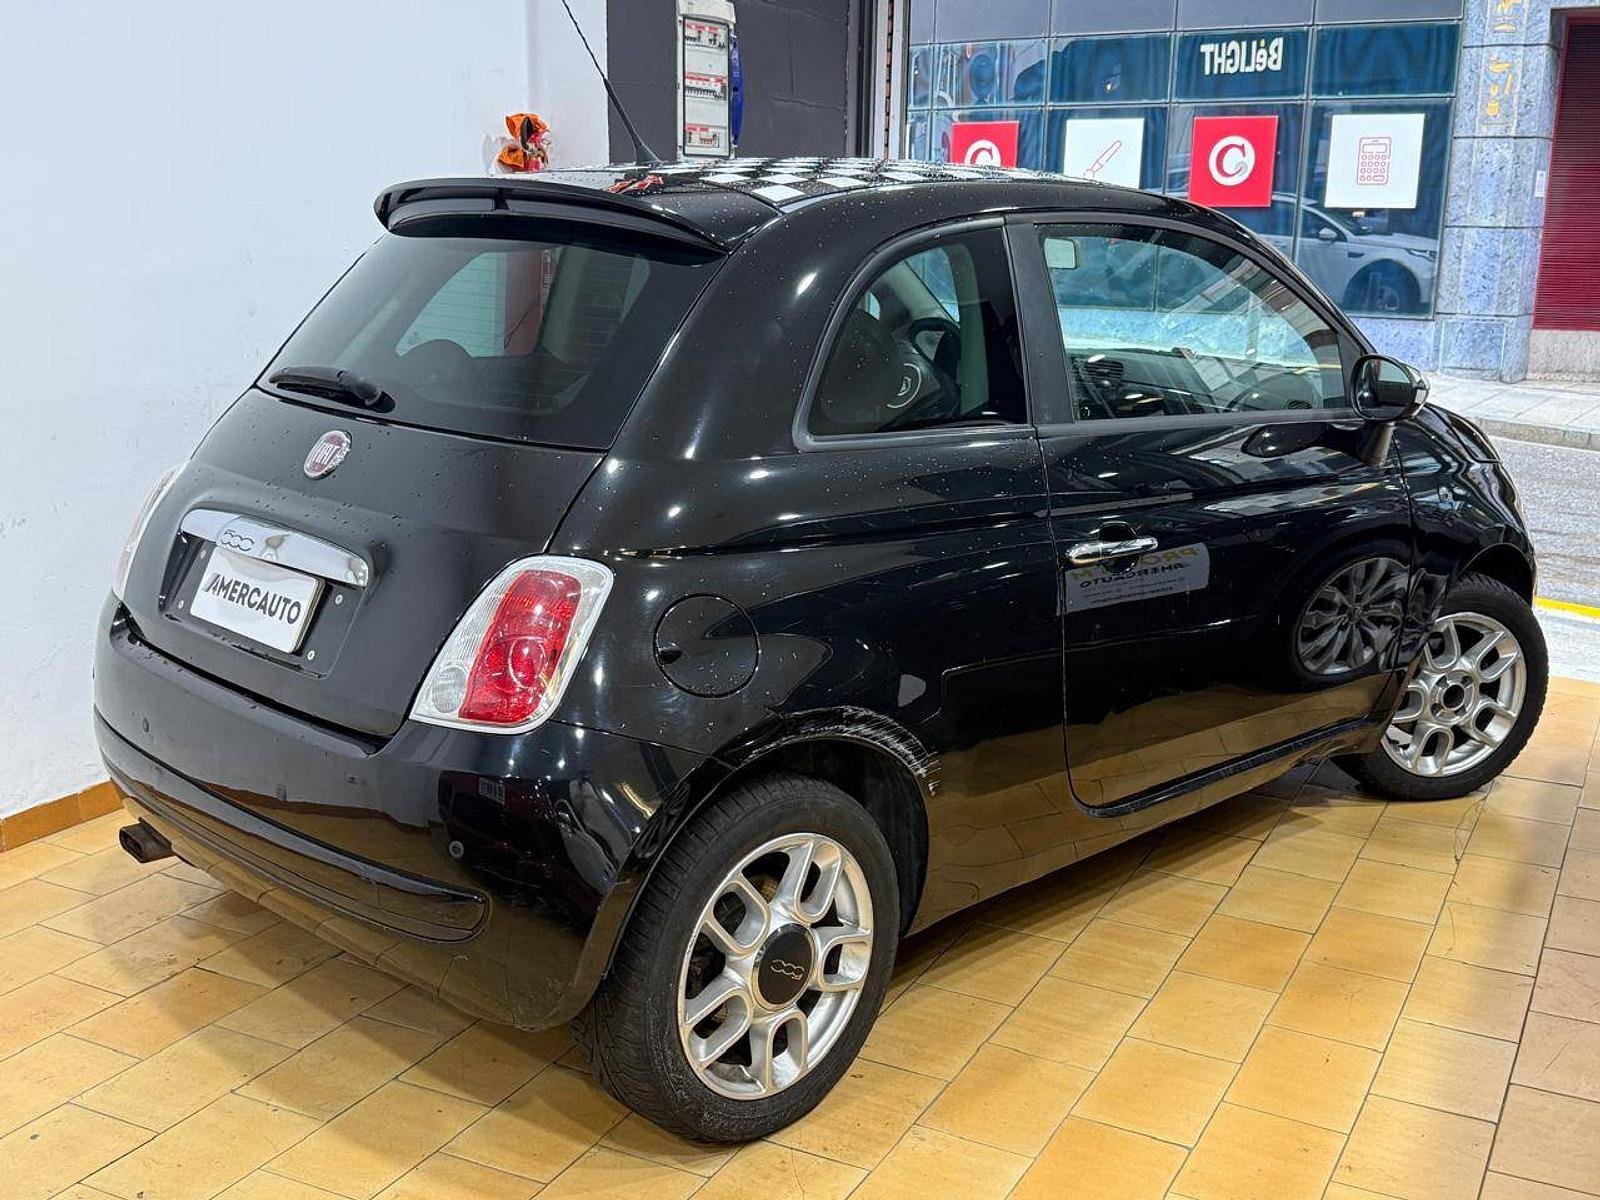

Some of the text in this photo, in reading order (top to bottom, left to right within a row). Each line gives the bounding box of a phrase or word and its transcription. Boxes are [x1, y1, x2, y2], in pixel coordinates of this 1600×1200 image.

[312, 442, 341, 465] FIAT
[220, 528, 254, 552] 500
[203, 573, 301, 625] AMERCAUTO
[770, 959, 805, 980] 500
